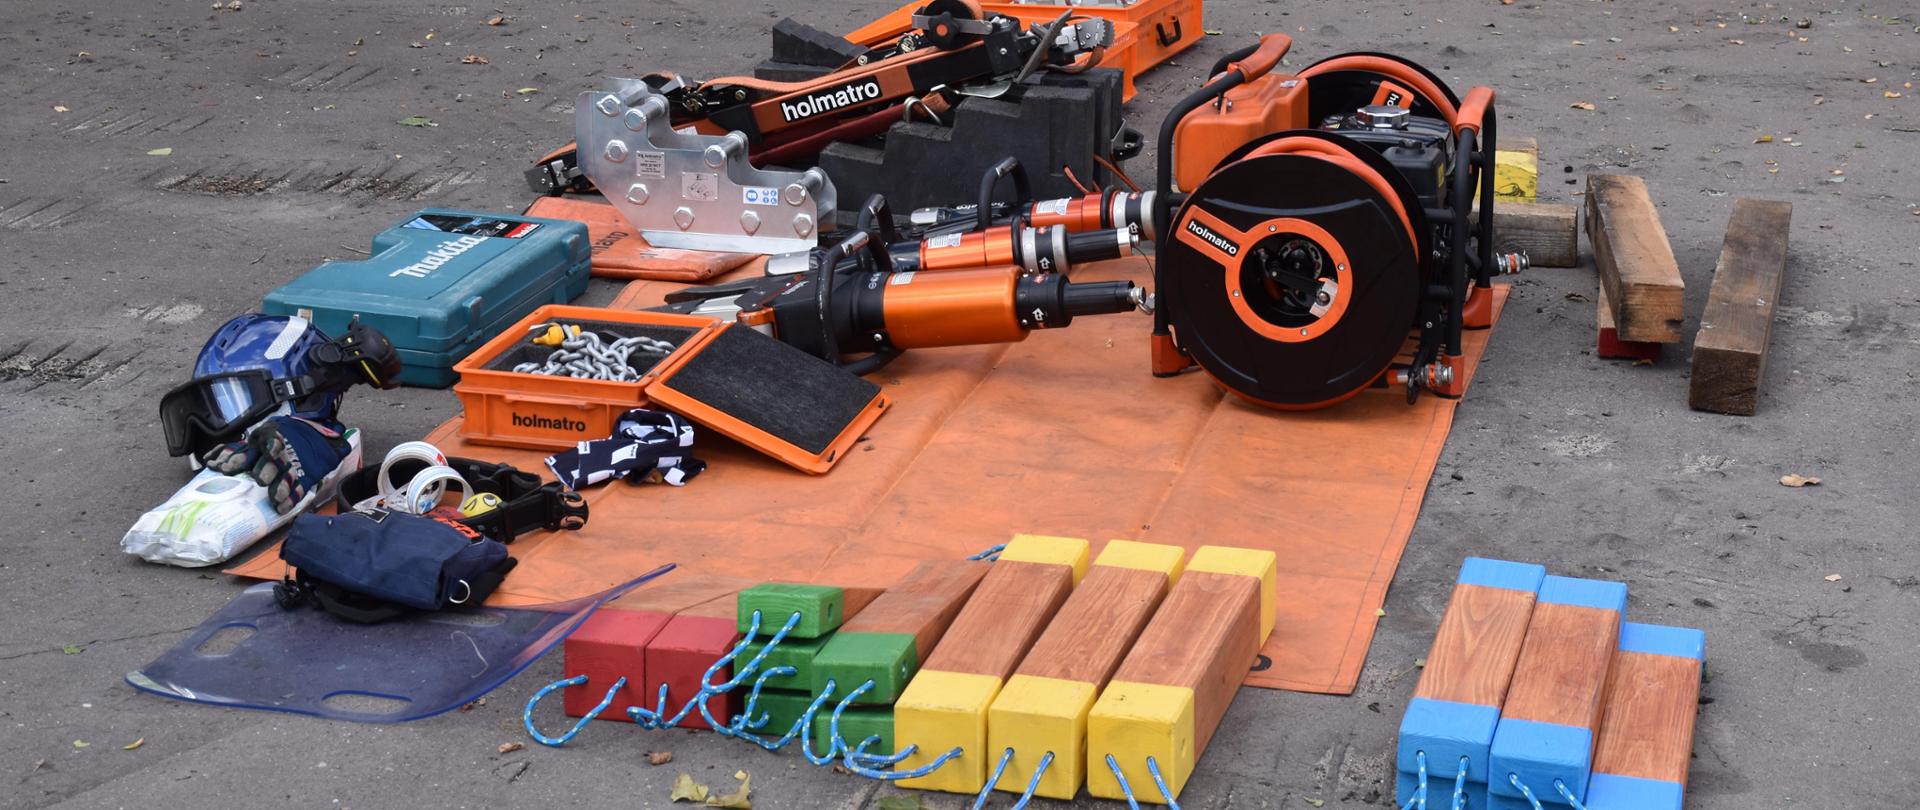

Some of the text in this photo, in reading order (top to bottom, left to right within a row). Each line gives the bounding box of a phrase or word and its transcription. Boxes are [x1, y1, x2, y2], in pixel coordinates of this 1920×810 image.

[781, 82, 879, 121] holmatro
[1188, 220, 1237, 255] holmatro
[512, 411, 586, 432] holmatro
